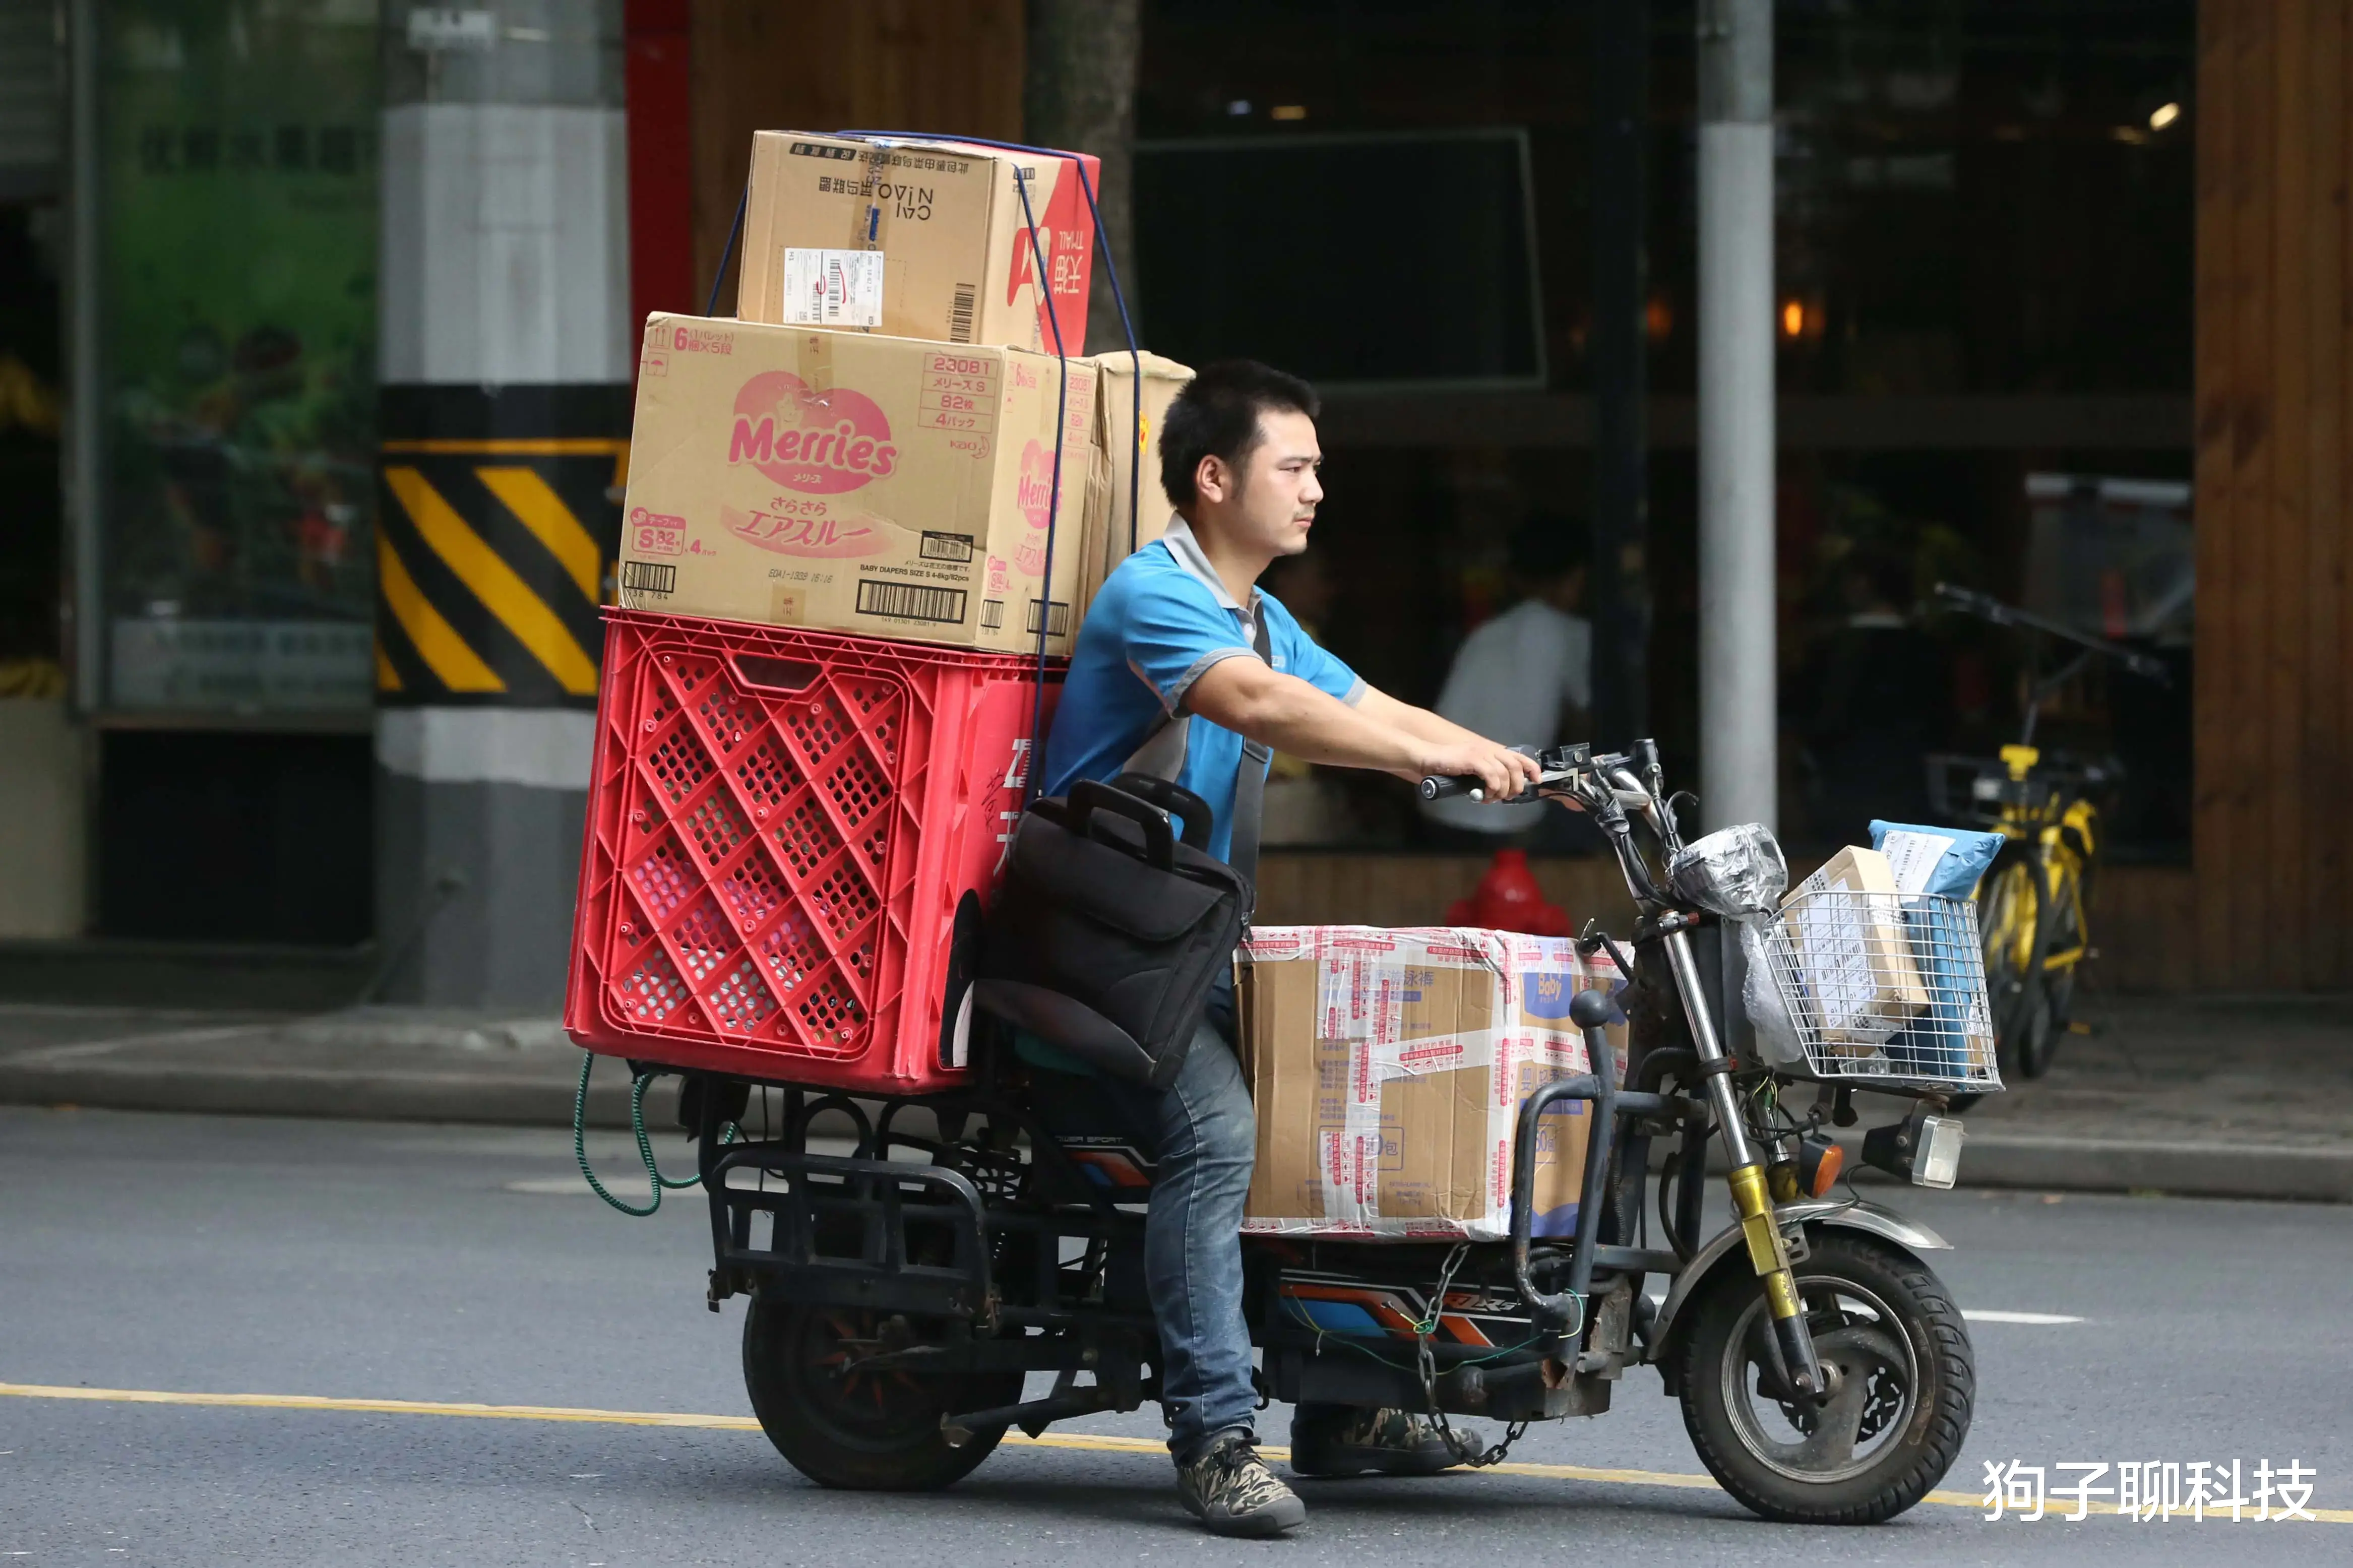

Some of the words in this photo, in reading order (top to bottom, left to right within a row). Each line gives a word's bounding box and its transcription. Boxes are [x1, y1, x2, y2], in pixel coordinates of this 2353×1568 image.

[819, 176, 873, 197] 菜鸟联盟
[1059, 230, 1084, 250] TMALL
[1053, 255, 1083, 295] 天猫
[674, 327, 689, 351] 6
[934, 357, 989, 375] 23081
[976, 381, 985, 392] S
[941, 395, 974, 410] 82枚
[935, 413, 975, 428] 4パック
[728, 417, 898, 475] Merries
[770, 496, 827, 517] さらさら
[734, 510, 873, 546] エアスルー
[860, 563, 879, 572] BABY
[880, 566, 908, 576] DIAPERS
[909, 569, 924, 577] SIZE
[651, 592, 668, 600] 784
